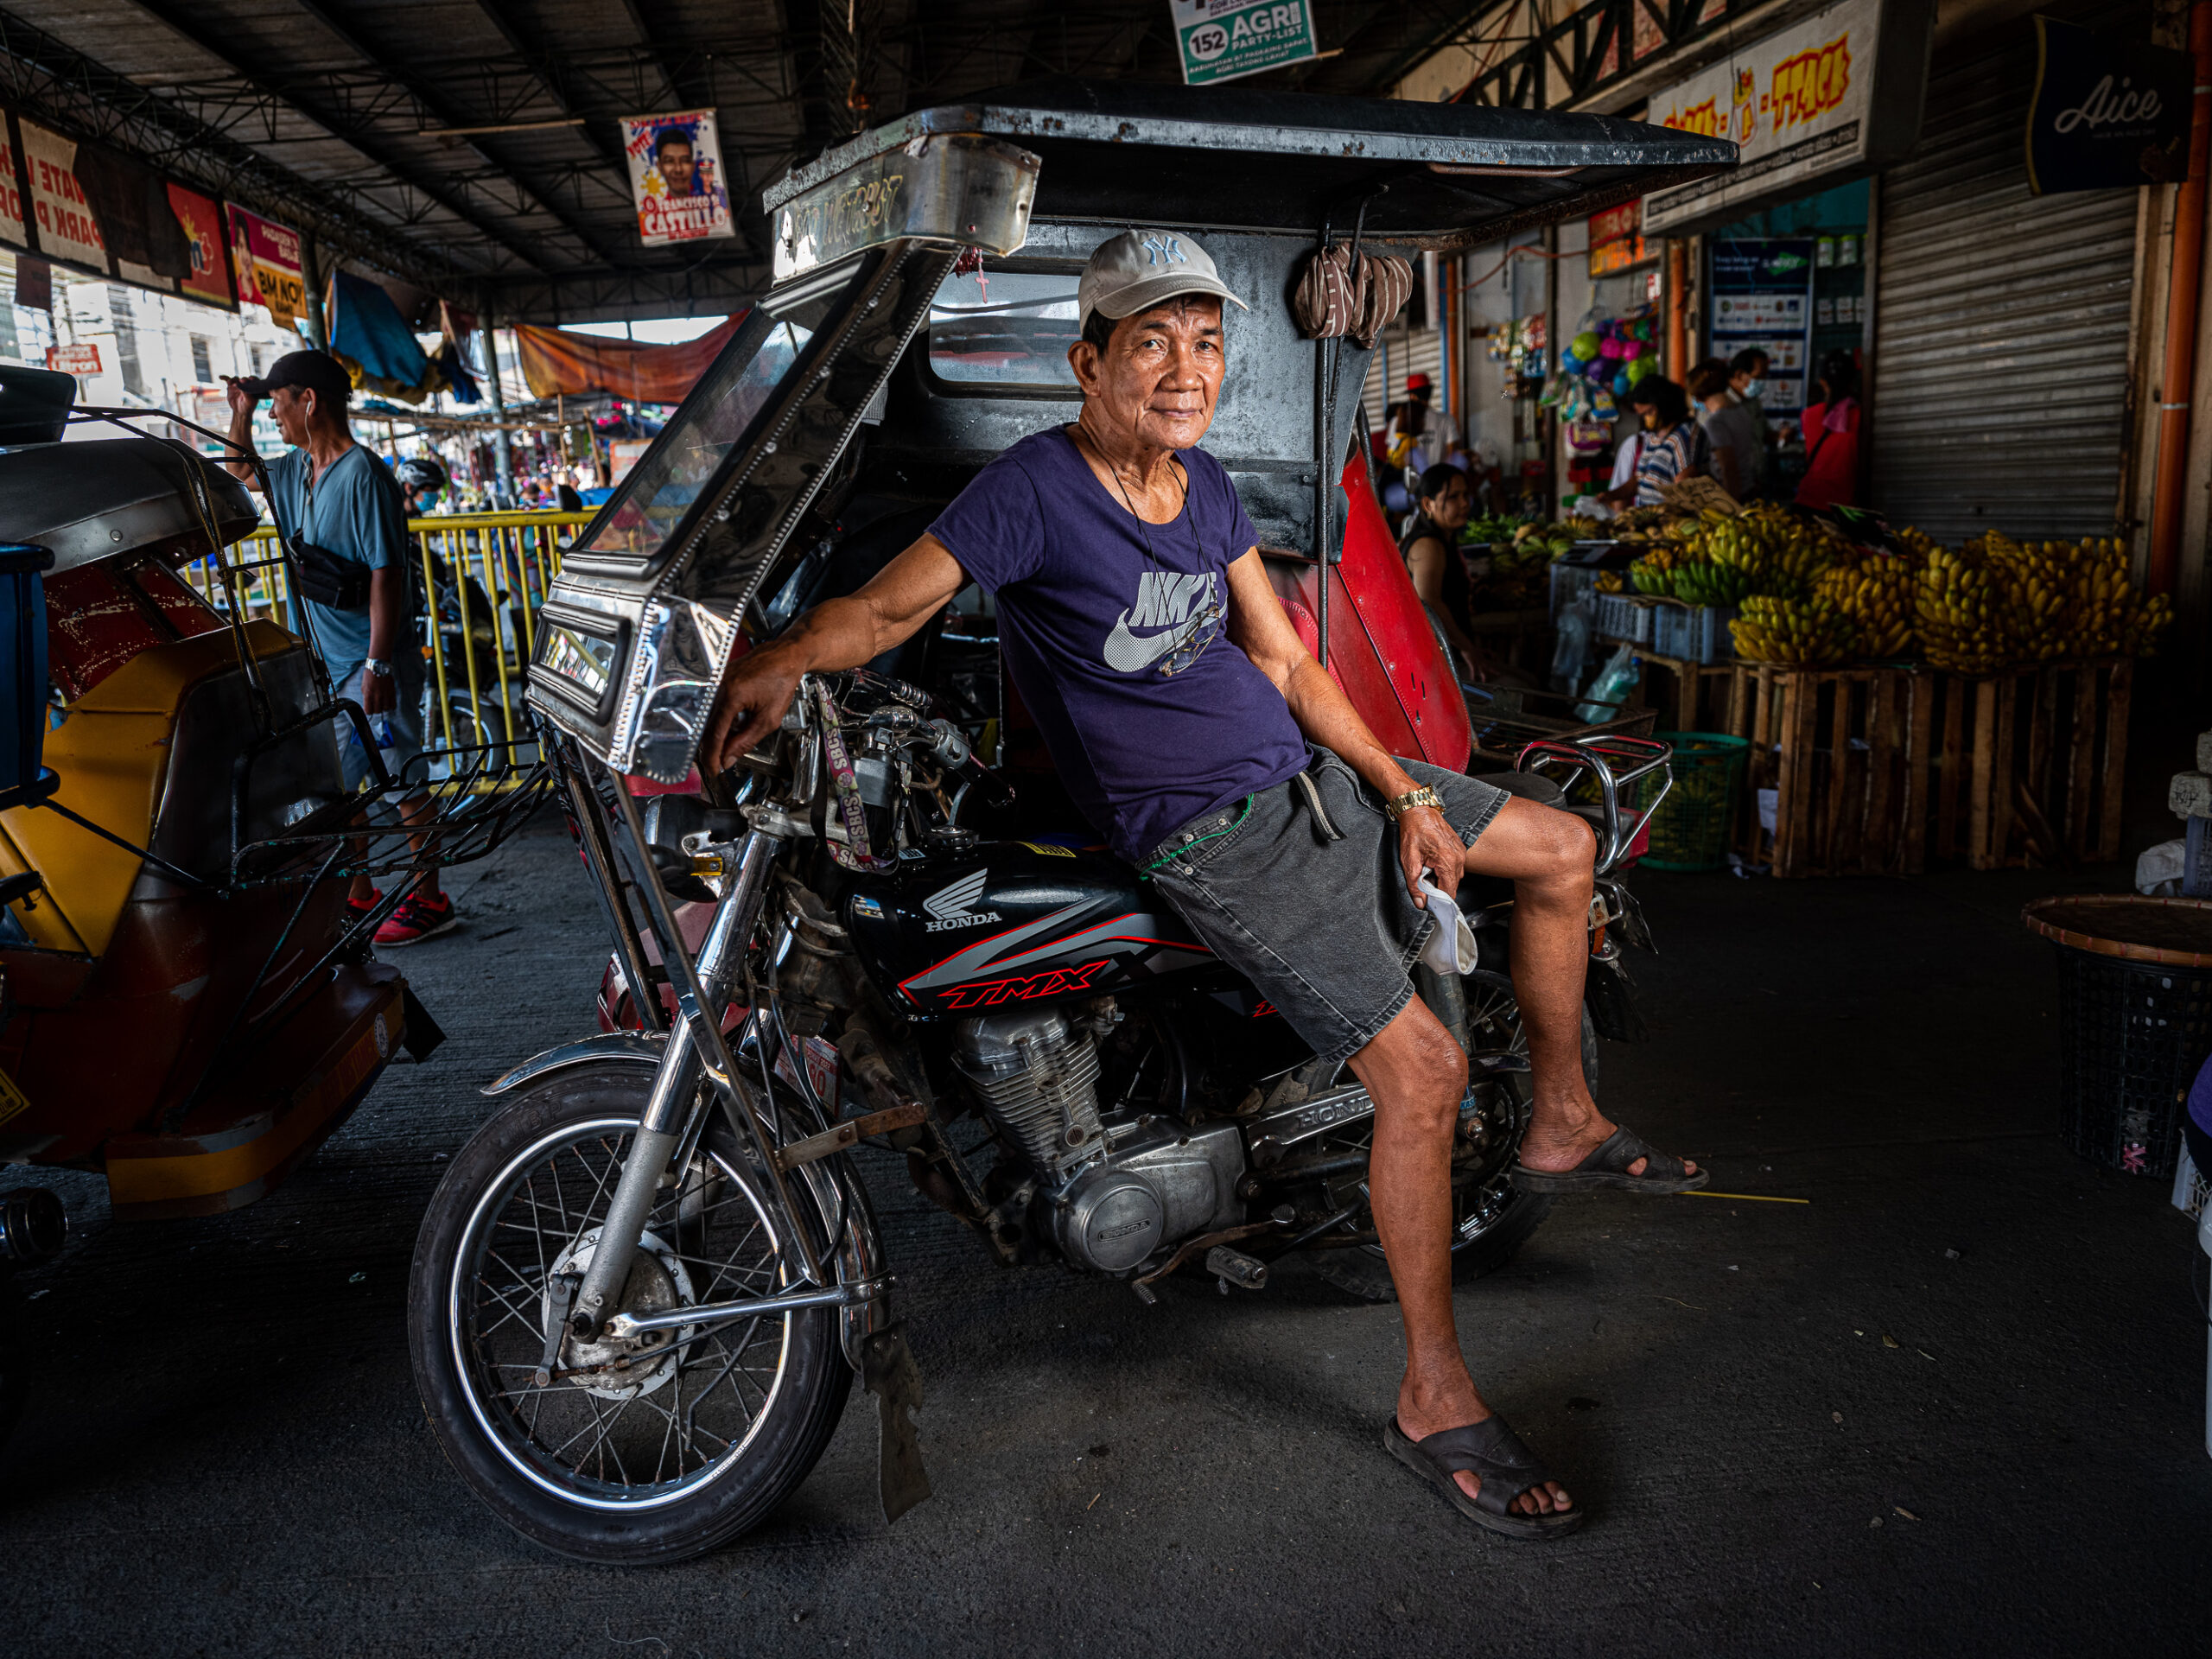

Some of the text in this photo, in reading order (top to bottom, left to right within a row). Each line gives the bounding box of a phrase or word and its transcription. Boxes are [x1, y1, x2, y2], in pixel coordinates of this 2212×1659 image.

[1232, 2, 1302, 40] AGRI
[1191, 30, 1225, 54] 152
[1231, 24, 1303, 51] PARTY-LIST
[2055, 74, 2163, 133] Aice
[626, 130, 655, 158] VOTE
[658, 194, 710, 213] FRANCISCO
[644, 206, 727, 235] CASTILLO
[1142, 236, 1187, 266] NY
[1128, 571, 1218, 627] NIKE
[826, 727, 849, 772] SBCS
[842, 794, 865, 837] SBCS
[925, 912, 1002, 932] HONDA
[937, 960, 1111, 1009] TMX
[1296, 1095, 1375, 1128] HOND
